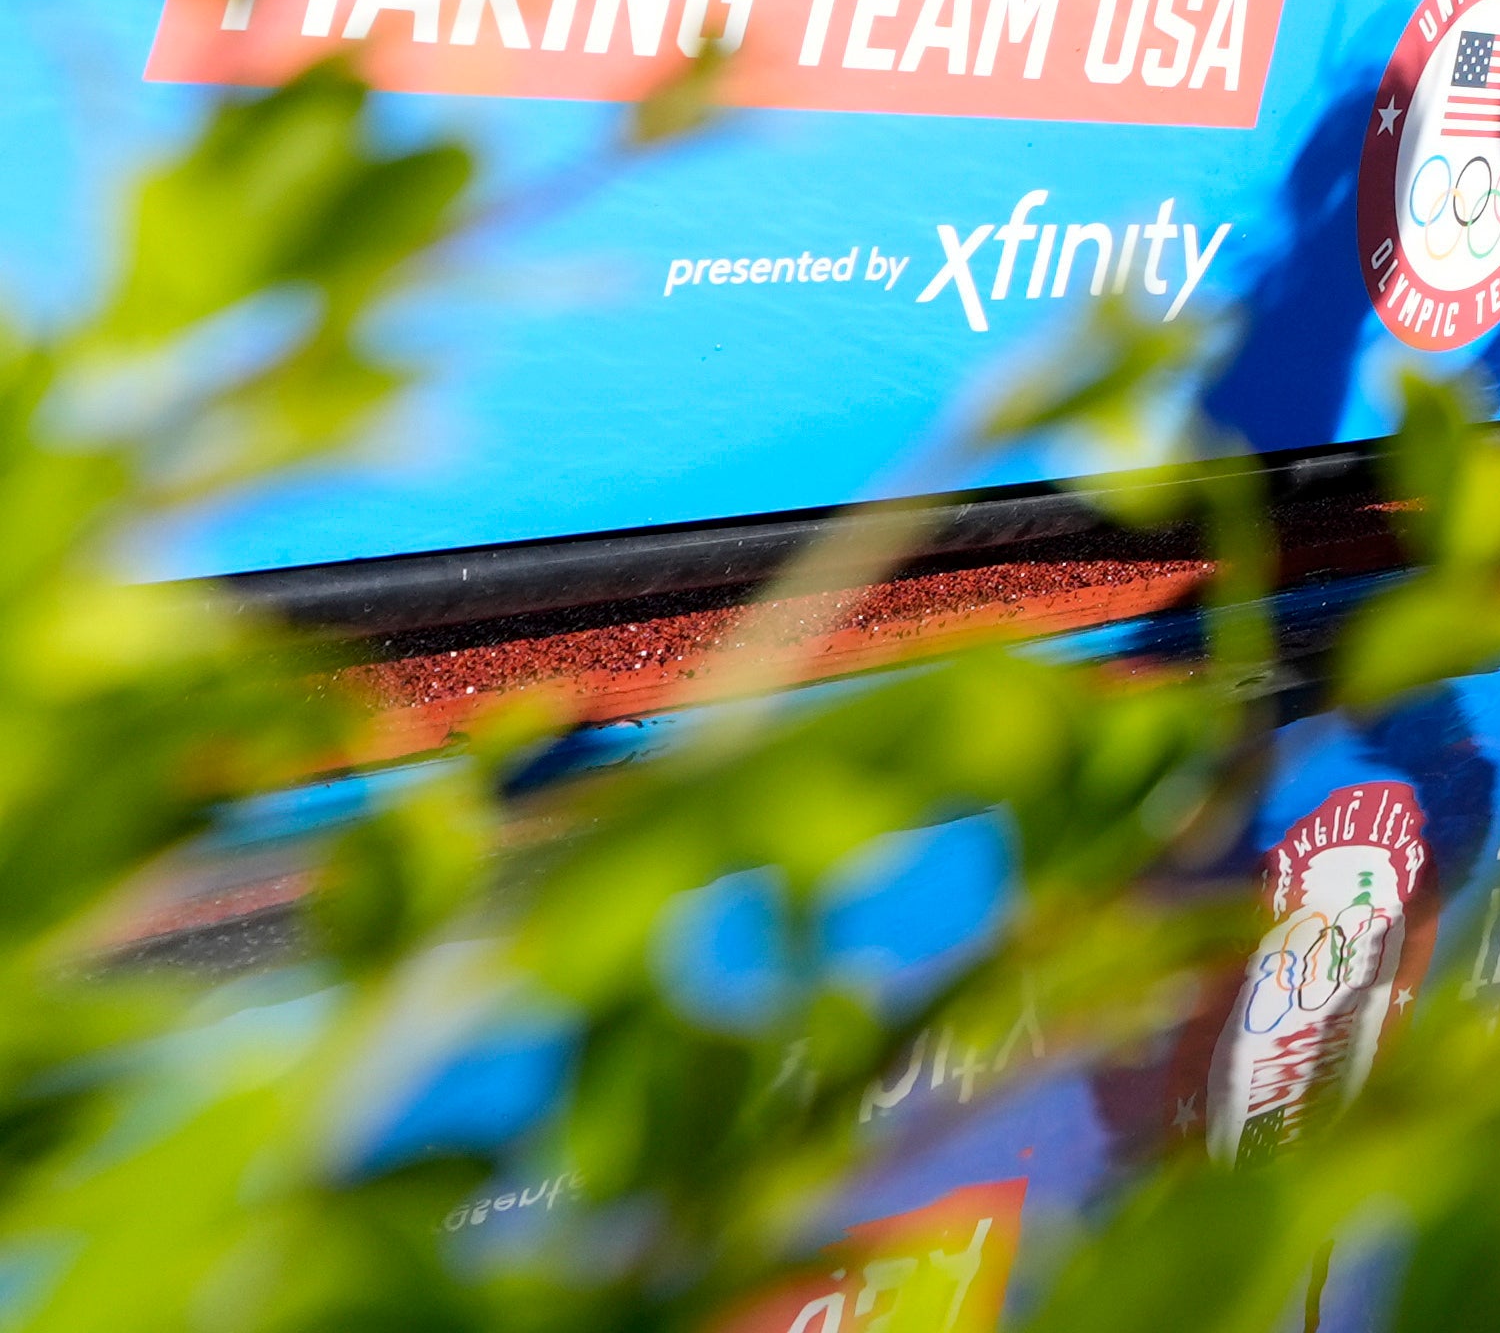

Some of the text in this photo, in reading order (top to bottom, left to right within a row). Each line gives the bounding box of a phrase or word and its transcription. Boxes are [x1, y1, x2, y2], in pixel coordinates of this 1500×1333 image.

[663, 190, 1232, 331] presented by xfinity
[1371, 237, 1457, 337] OLYMPIC
